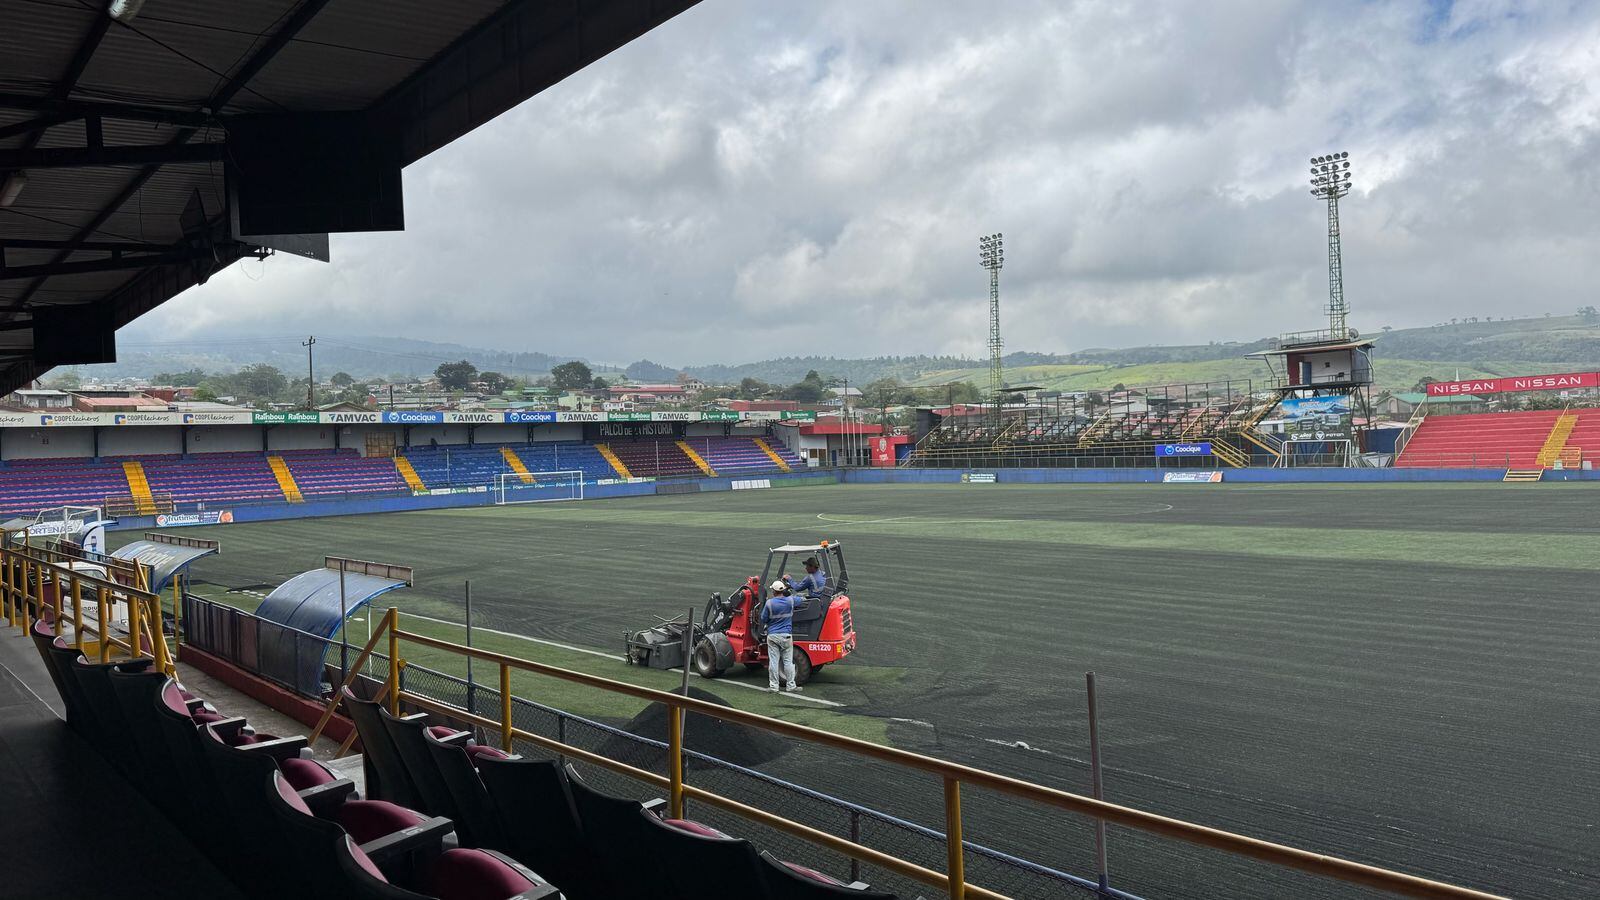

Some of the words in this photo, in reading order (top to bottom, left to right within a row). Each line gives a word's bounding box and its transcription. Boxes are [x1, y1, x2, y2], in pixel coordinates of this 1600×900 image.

[1515, 376, 1581, 388] NISSAN
[1434, 382, 1494, 393] NISSAN
[255, 412, 284, 420] Rainbow
[288, 412, 317, 420] Rainbow
[336, 414, 376, 422] AMVAC
[401, 413, 436, 422] Coocique
[458, 414, 493, 422] AMVAC
[521, 413, 551, 422] Coocique
[567, 413, 598, 421] AMVAC
[600, 423, 623, 436] PALCO
[642, 422, 673, 435] HISTORIA
[1175, 445, 1201, 453] Coocique
